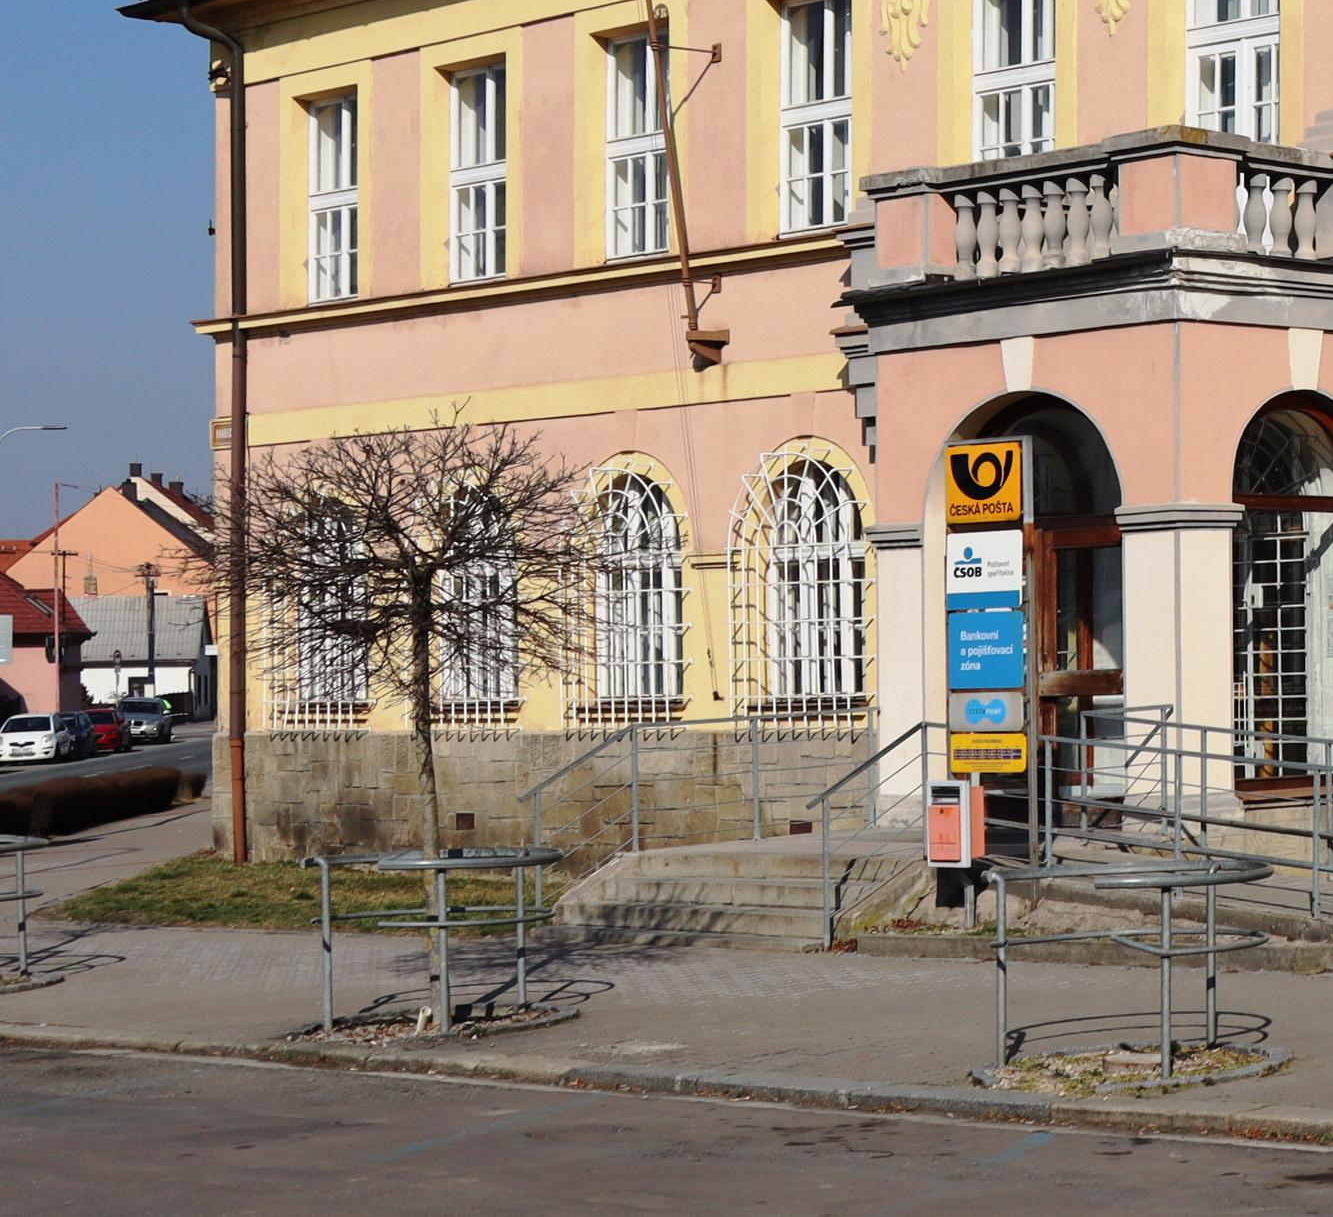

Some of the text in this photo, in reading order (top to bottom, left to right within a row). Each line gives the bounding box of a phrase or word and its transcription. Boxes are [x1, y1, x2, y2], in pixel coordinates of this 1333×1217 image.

[949, 500, 1014, 516] ČESKÁ POŠTA
[953, 566, 982, 578] ČSOB
[960, 629, 999, 641] Bankovní
[960, 644, 1014, 658] a pojišťovací
[960, 660, 981, 671] zóna
